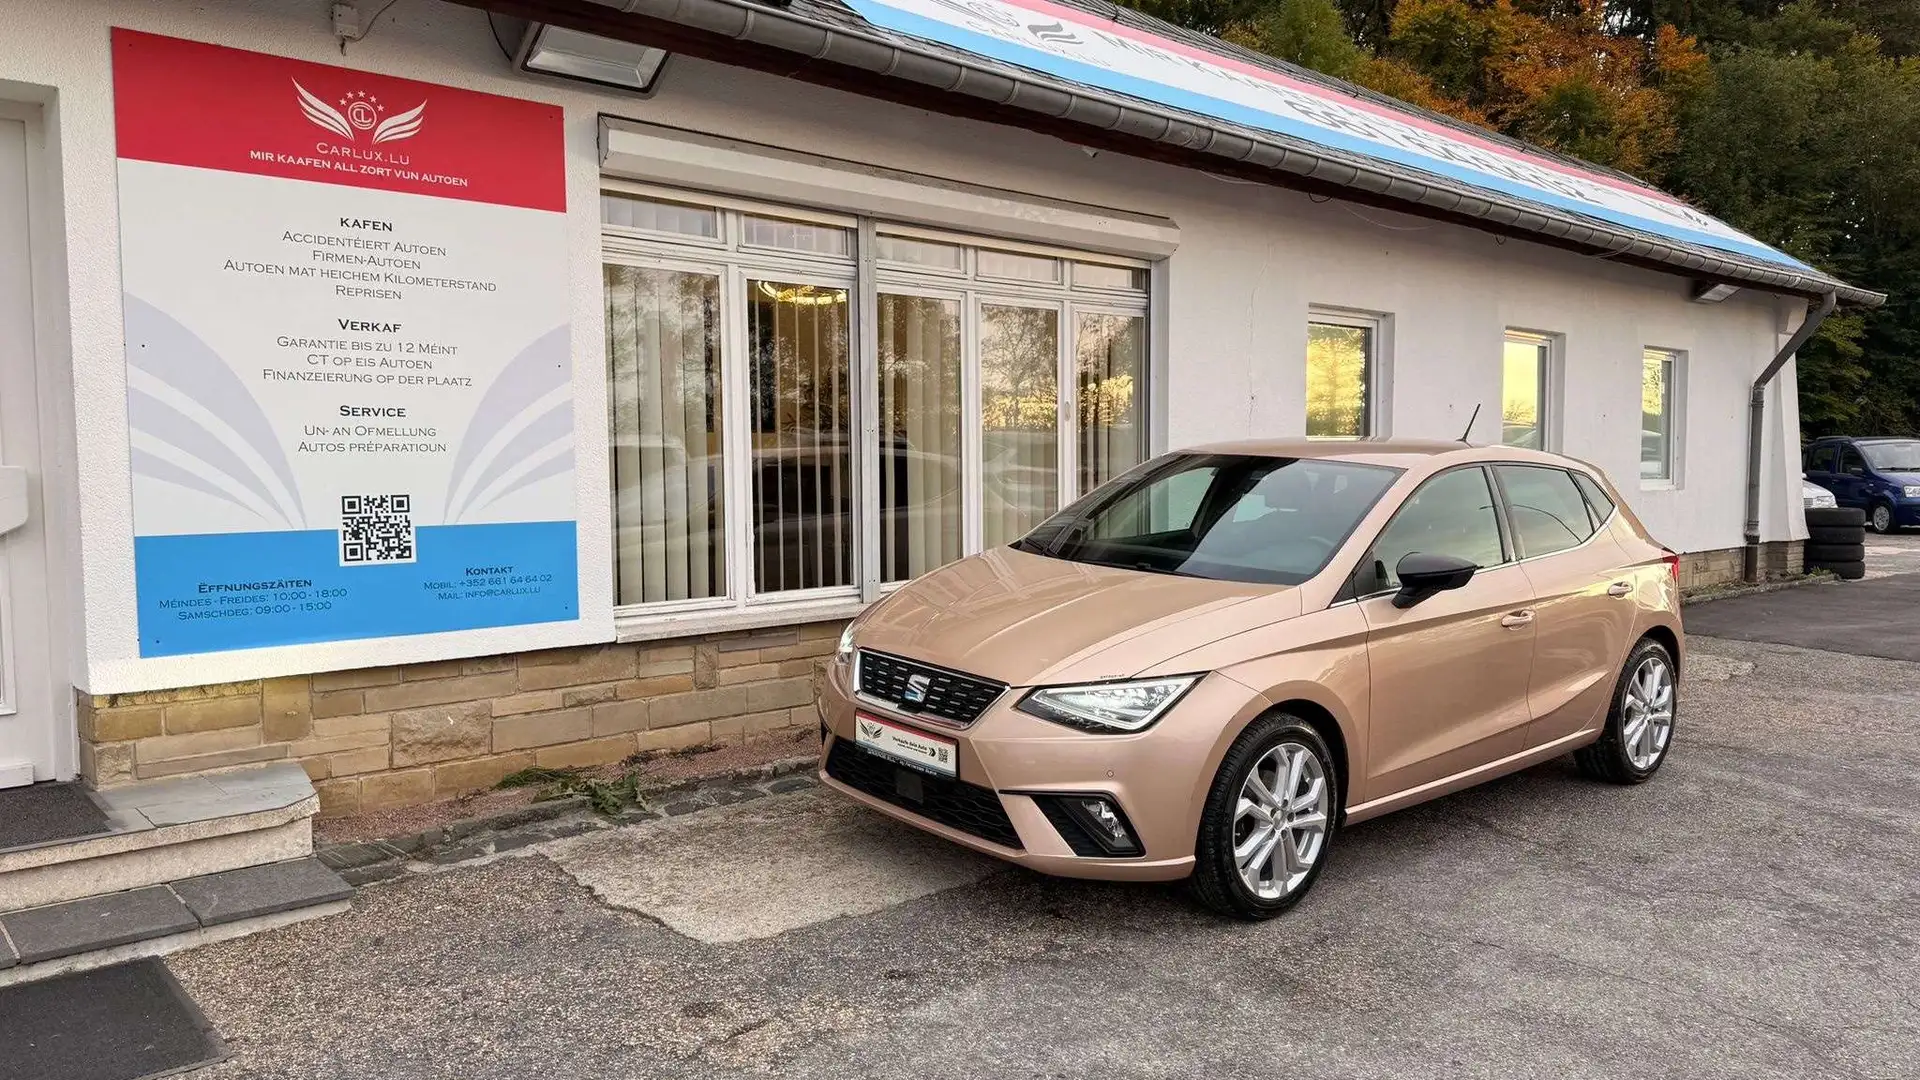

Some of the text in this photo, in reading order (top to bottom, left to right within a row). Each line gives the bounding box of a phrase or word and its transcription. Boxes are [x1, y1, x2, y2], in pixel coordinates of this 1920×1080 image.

[316, 142, 410, 165] CARLUX.LU
[250, 149, 468, 187] MIR KAAFEN ALL ZORT VUN AUTOEN
[340, 217, 393, 232] KAFEN
[282, 230, 447, 257] ACCIDENTÉIERT AUTOEN
[312, 249, 421, 270] FIRMEN-AUTOEN
[223, 259, 497, 292] AUTOEN MAT HEICHEM KILOMETERSTAND
[335, 285, 402, 300] REPRISEN
[338, 318, 402, 334] VERKAF
[277, 336, 458, 355] GARANTIE BIS ZU 12 MÉINT
[307, 354, 433, 369] CT OP EIS AUTOEN
[263, 368, 473, 387] FINANZEIERUNG OP DER PLAATZ
[339, 405, 406, 418] SERVICE
[304, 425, 437, 437] UN- AN OFMELLUNG
[298, 441, 447, 453] AUTOS PRÉPARATIOUN
[465, 566, 514, 577] KONTAKT
[198, 579, 313, 594] ËFFNUNGSZÄITEN
[220, 594, 269, 605] FREIDES:
[273, 591, 307, 601] 10:00
[315, 588, 348, 599] 18:00
[178, 608, 253, 621] SAMSCHDEG:
[255, 604, 291, 615] 09:00
[299, 601, 332, 612] 15:00
